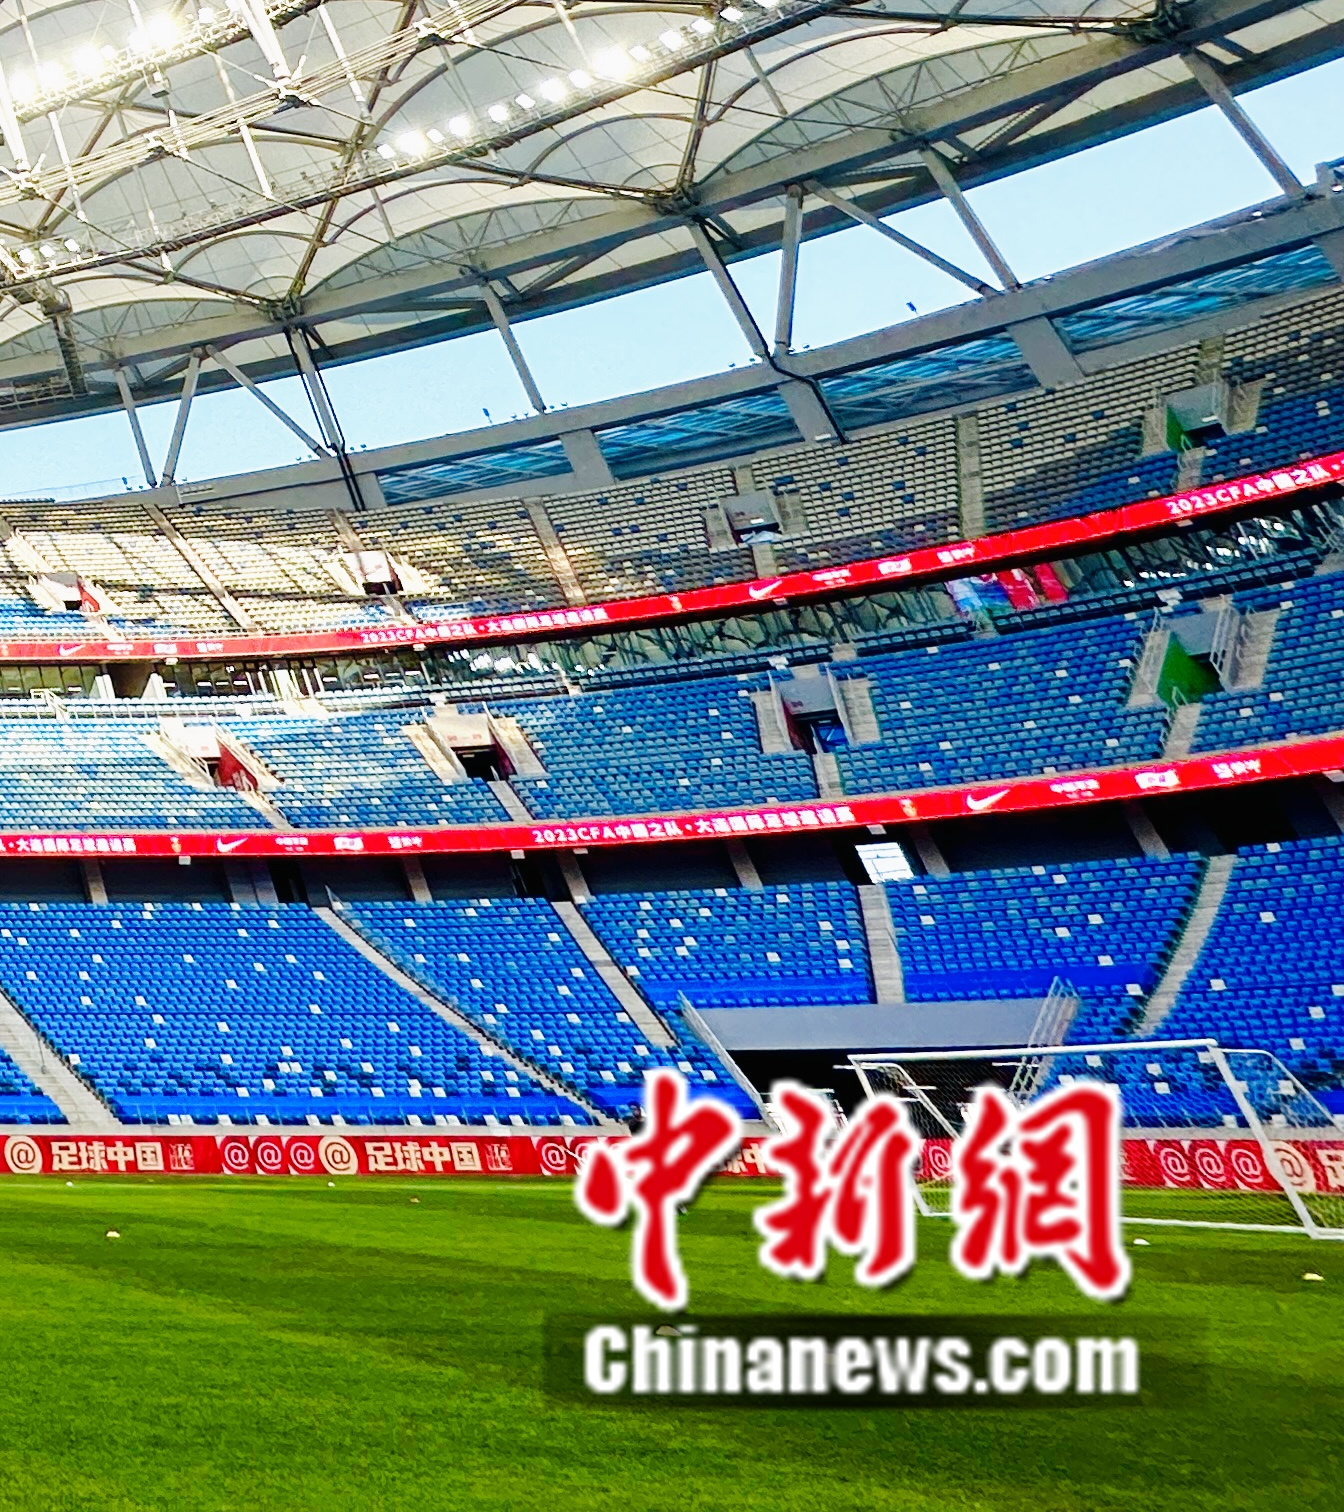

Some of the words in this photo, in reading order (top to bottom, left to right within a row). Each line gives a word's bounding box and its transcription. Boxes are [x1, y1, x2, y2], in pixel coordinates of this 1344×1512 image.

[50, 1141, 165, 1172] 足球中国
[224, 1142, 249, 1170] @
[257, 1142, 282, 1170] @
[290, 1142, 315, 1170] @
[365, 1141, 483, 1172] 足球中国
[541, 1142, 569, 1172] @
[928, 1144, 953, 1177] @
[1160, 1147, 1191, 1182] @
[1195, 1148, 1226, 1182] @
[1230, 1148, 1263, 1183] @
